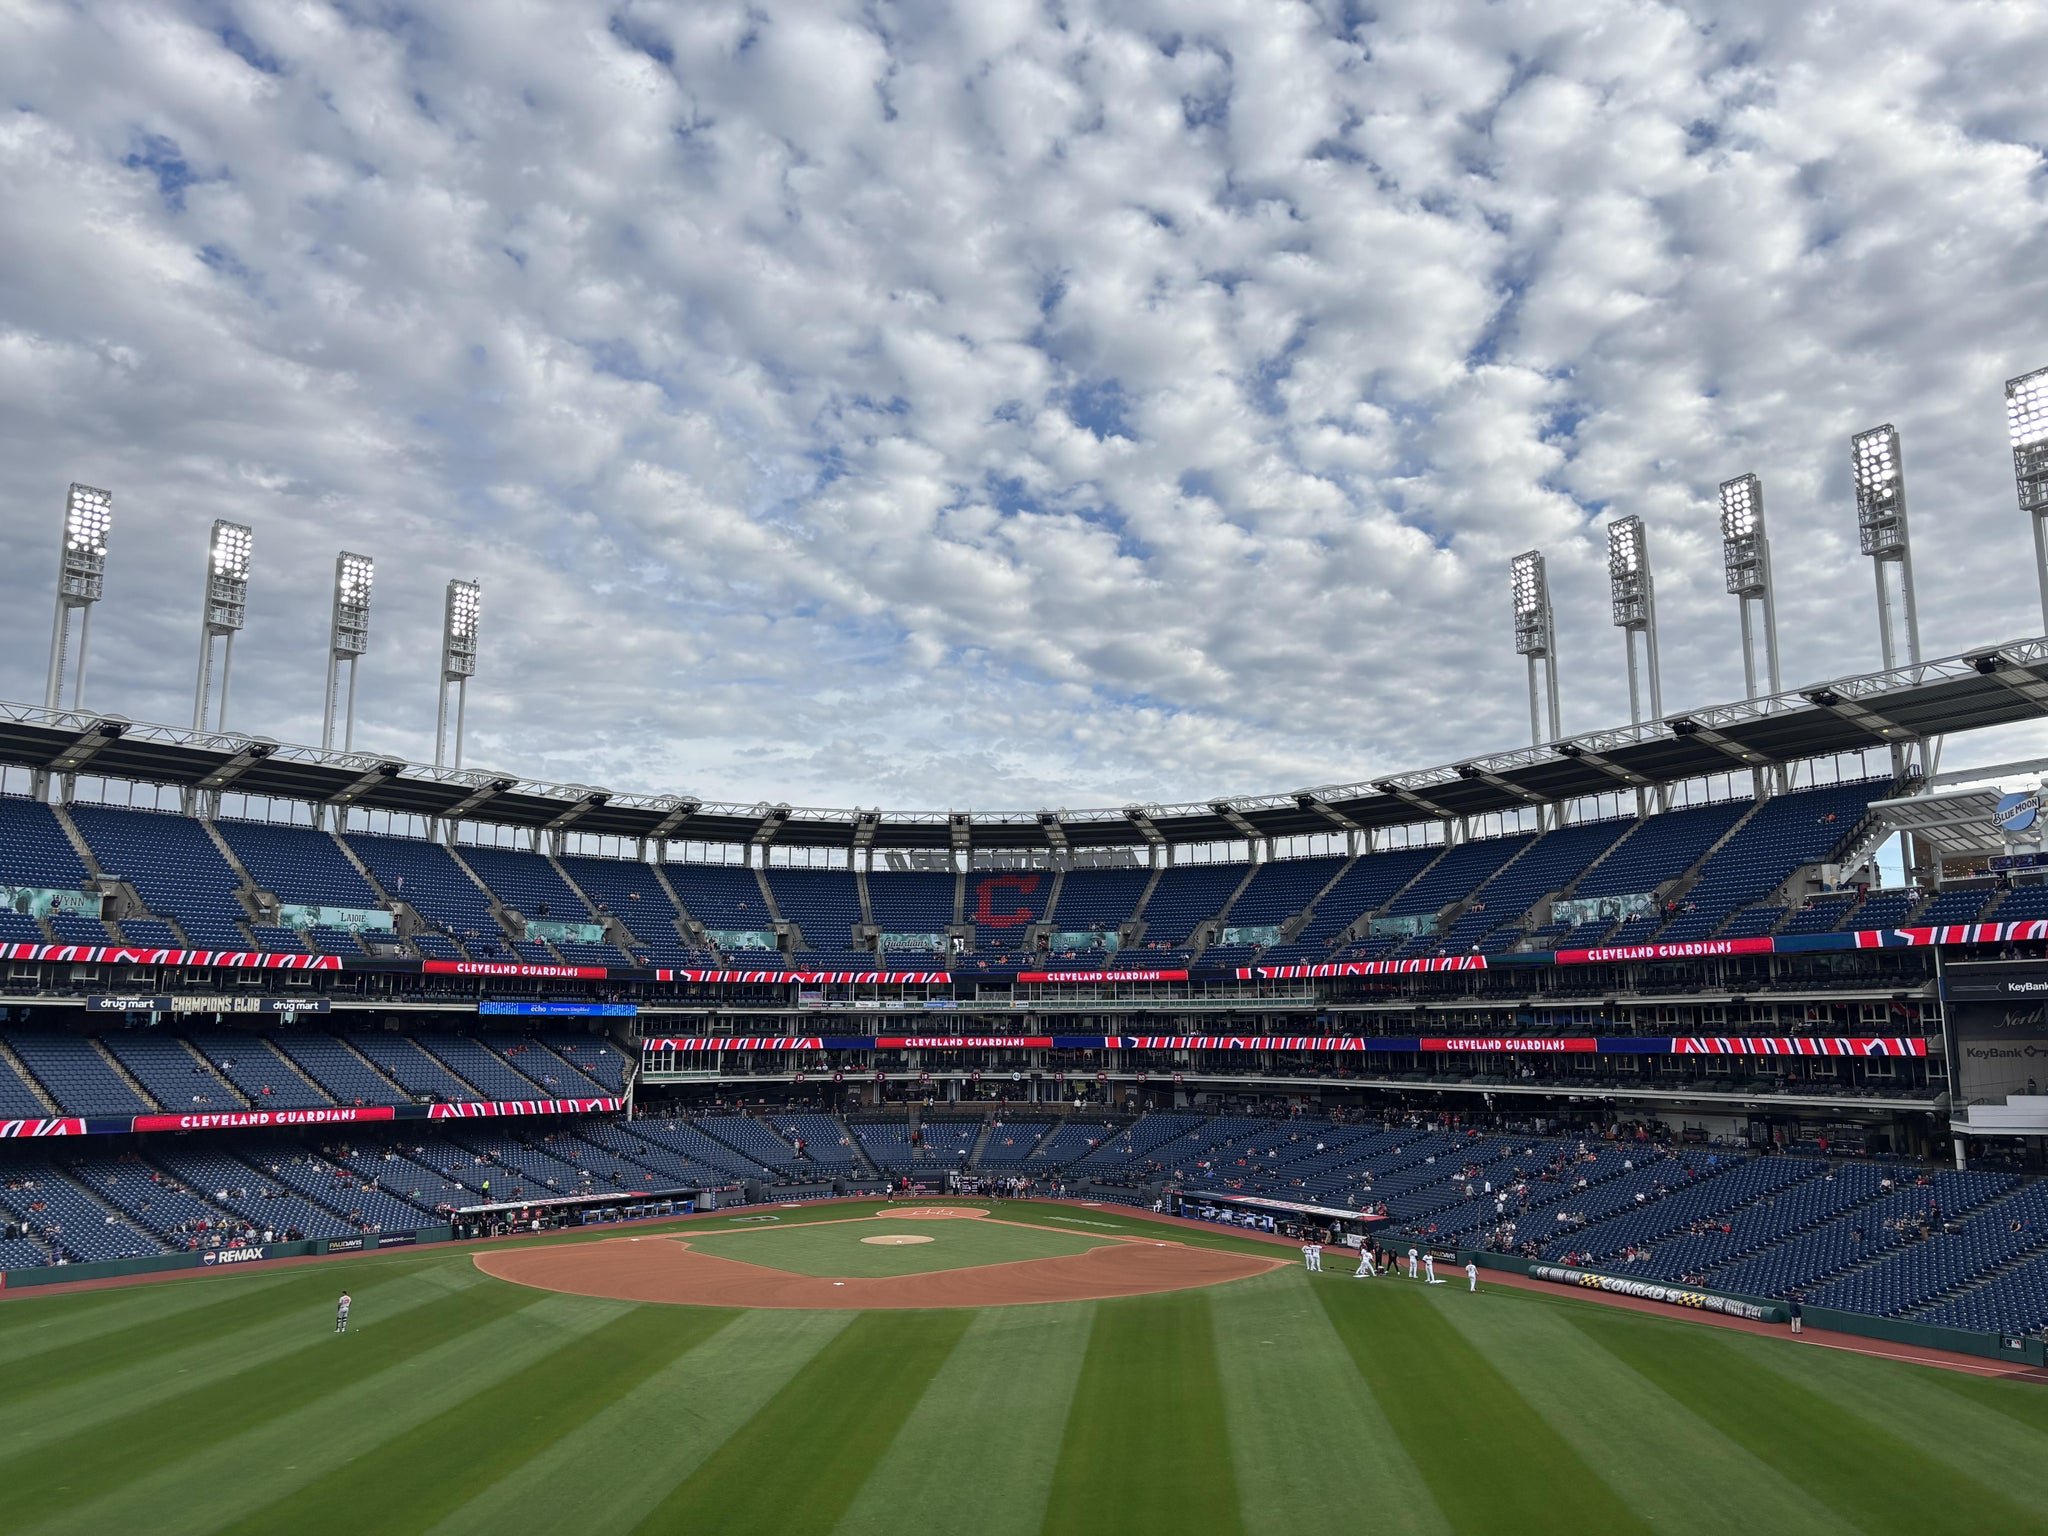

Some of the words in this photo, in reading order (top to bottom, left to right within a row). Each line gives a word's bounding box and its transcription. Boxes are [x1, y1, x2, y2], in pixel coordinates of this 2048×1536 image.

[1993, 809, 2014, 825] BLUE
[2015, 798, 2037, 815] MOON
[975, 874, 1040, 928] C
[883, 936, 928, 949] Guardians
[1587, 946, 1654, 961] CLEVELAND
[1659, 941, 1732, 957] GUARDIANS
[457, 963, 518, 975] CLEVELAND
[521, 966, 578, 977] GUARDIANS
[1047, 973, 1103, 981] CLEVELAND
[1106, 972, 1160, 980] GUARDIANS
[100, 999, 127, 1010] drug
[128, 999, 155, 1008] mart
[171, 997, 232, 1012] CHAMPIONS
[234, 997, 261, 1012] CLUB
[273, 1001, 295, 1012] drug
[296, 1001, 319, 1010] mart
[530, 1004, 547, 1013] echo
[905, 1038, 963, 1047] CLEVELAND
[967, 1038, 1025, 1047] GUARDIANS
[1446, 1040, 1501, 1050] CLEVELAND
[1505, 1040, 1565, 1050] GUARDIANS
[1966, 1047, 2023, 1060] KeyBank
[180, 1113, 270, 1128] CLEVELAND
[275, 1109, 356, 1124] GUARDIANS
[219, 1247, 263, 1264] REMAX
[1601, 1278, 1681, 1303] CONRAD'S
